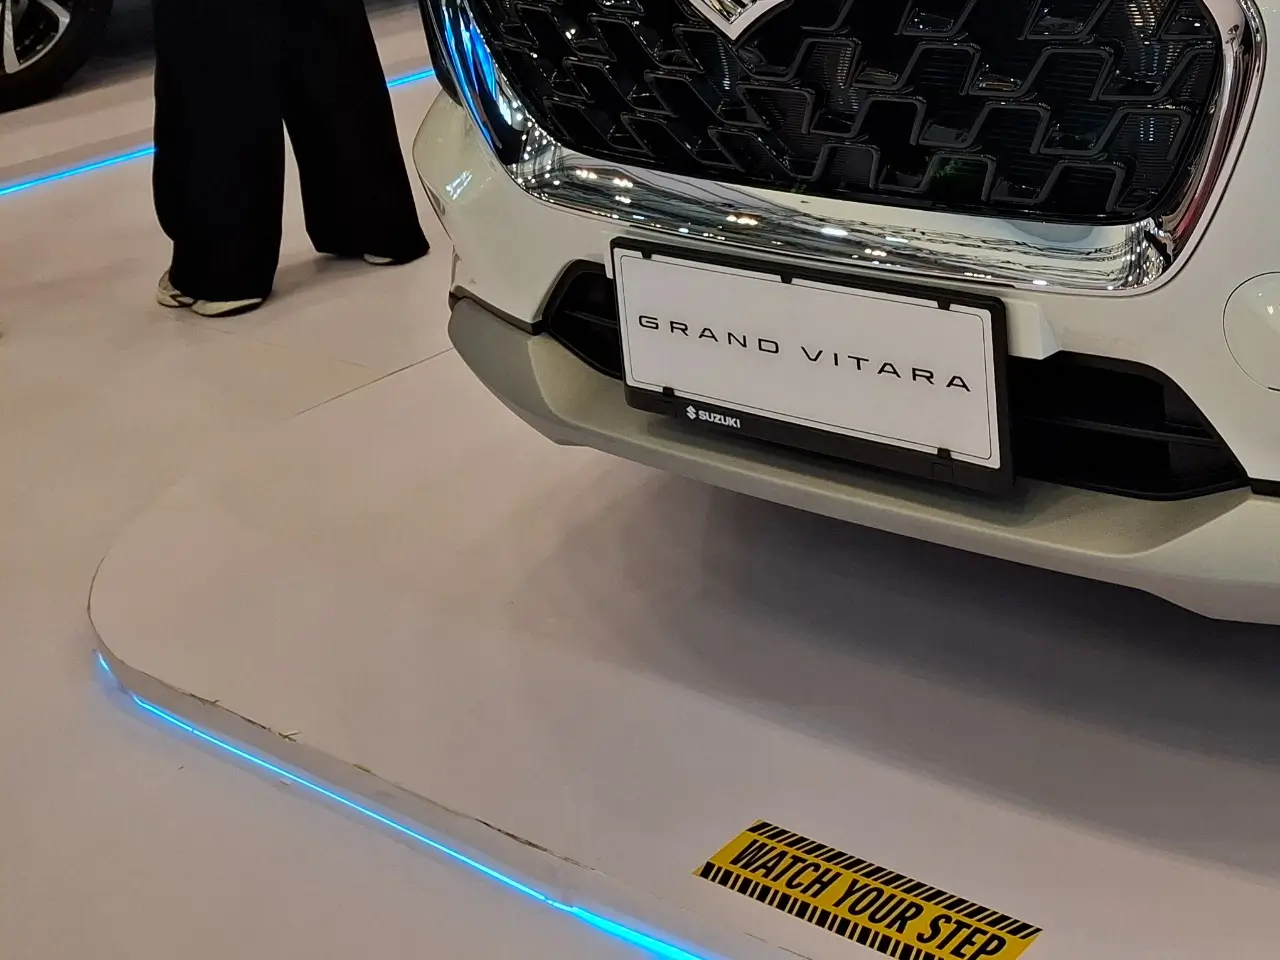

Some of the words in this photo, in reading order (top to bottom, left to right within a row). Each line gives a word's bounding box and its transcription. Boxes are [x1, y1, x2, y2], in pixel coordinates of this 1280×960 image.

[638, 314, 780, 355] GRAND
[800, 345, 972, 393] VITARA
[698, 409, 741, 429] SUZUKI
[728, 838, 843, 900] WATCH
[831, 877, 924, 935] YOUR
[916, 912, 1007, 960] STEP
